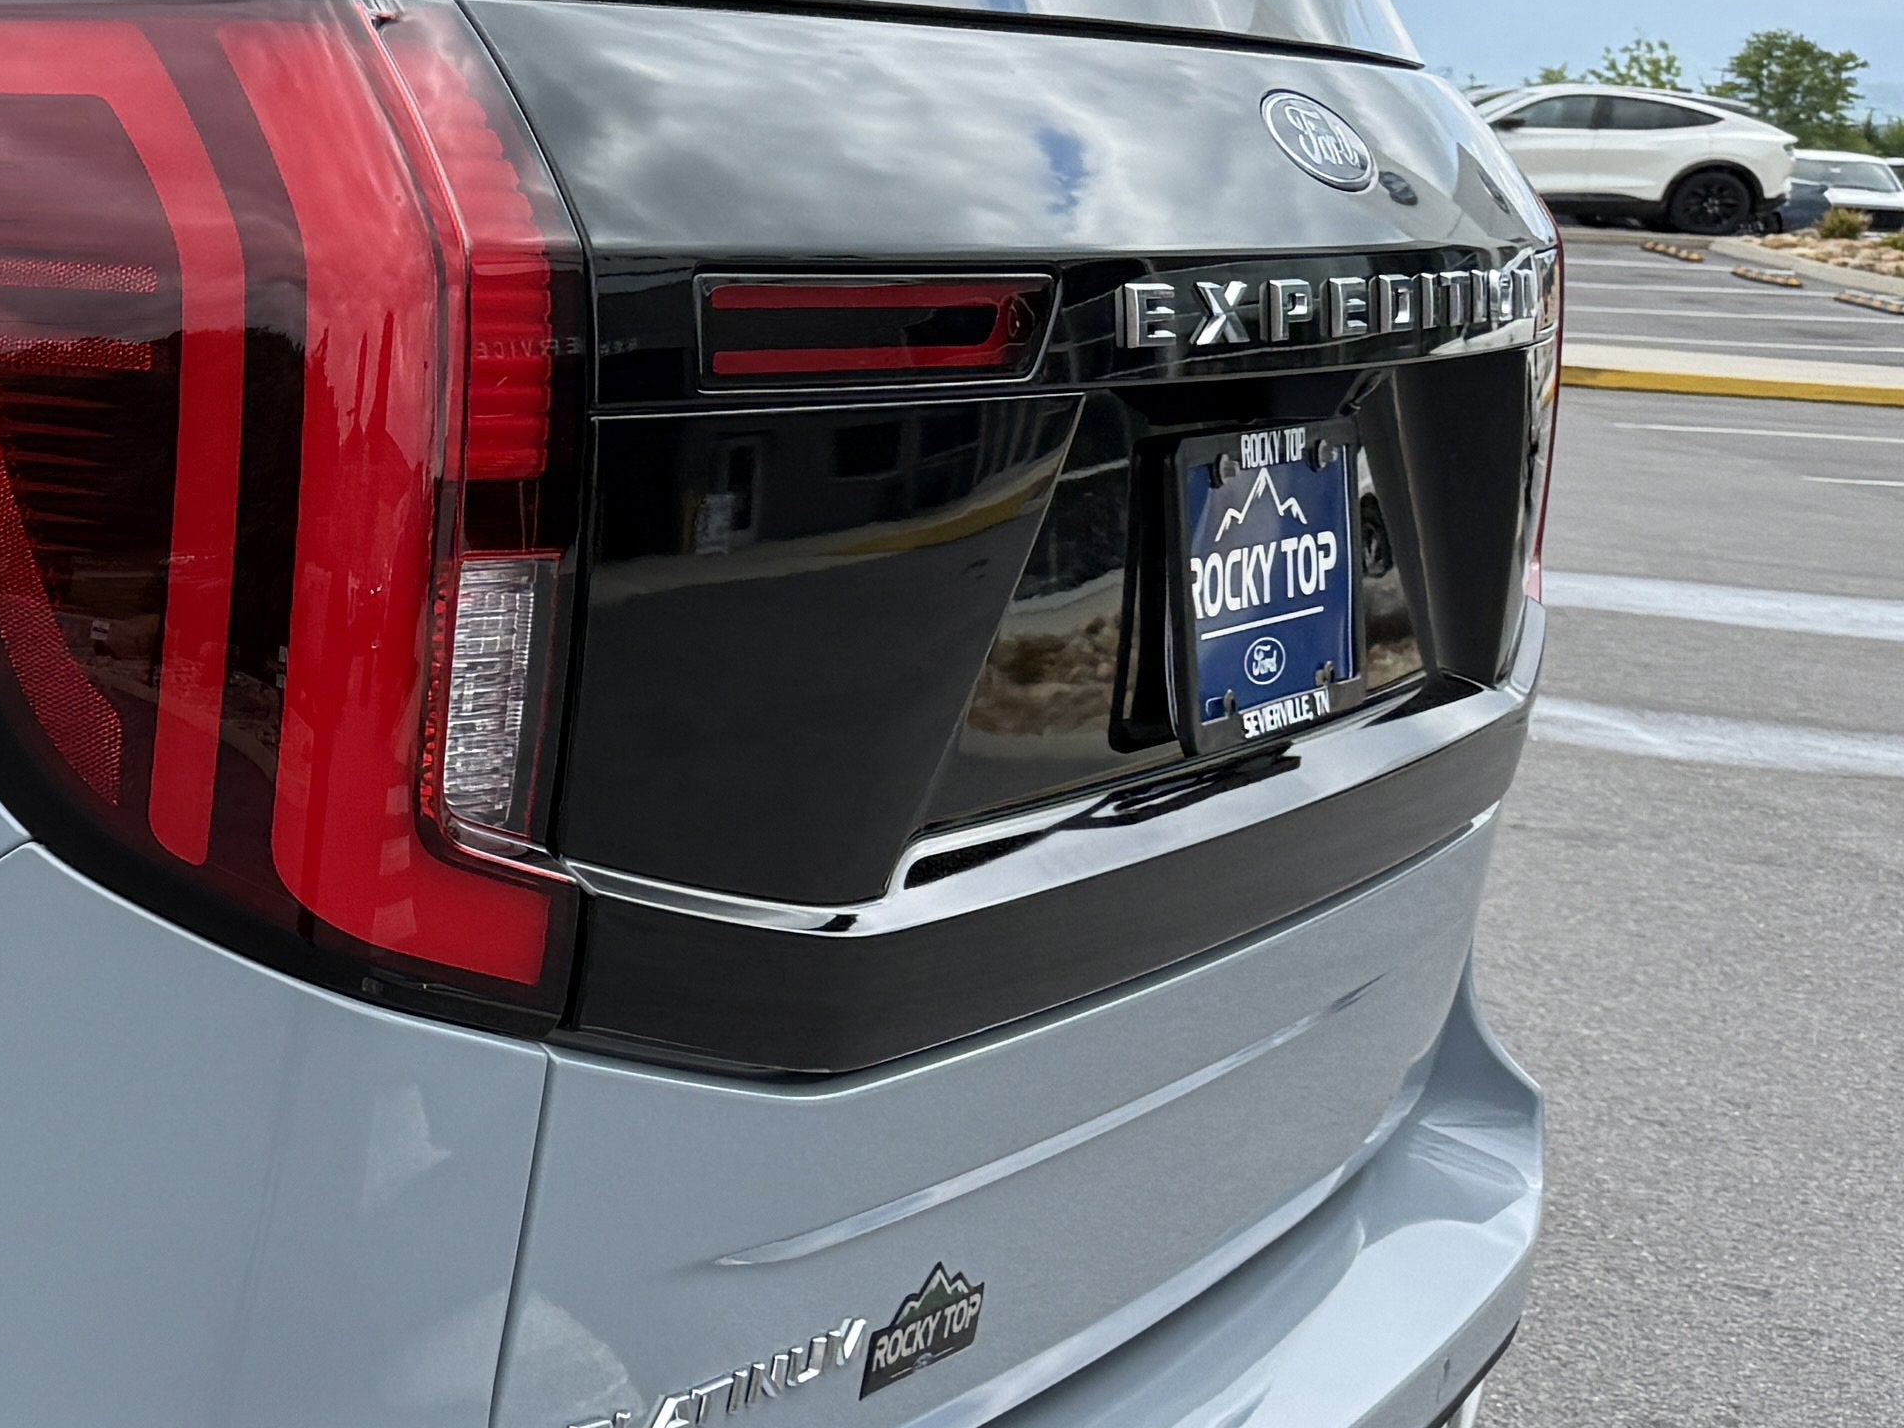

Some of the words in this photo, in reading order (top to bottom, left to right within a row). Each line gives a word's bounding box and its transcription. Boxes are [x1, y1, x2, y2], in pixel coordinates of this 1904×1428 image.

[1240, 430, 1281, 469] ROCKY
[1284, 426, 1306, 463] TOP
[1190, 544, 1276, 620] ROCKY
[1280, 530, 1338, 600] TOP
[1313, 689, 1331, 717] TN
[872, 1310, 942, 1372] ROCKY
[944, 1293, 982, 1339] TOP
